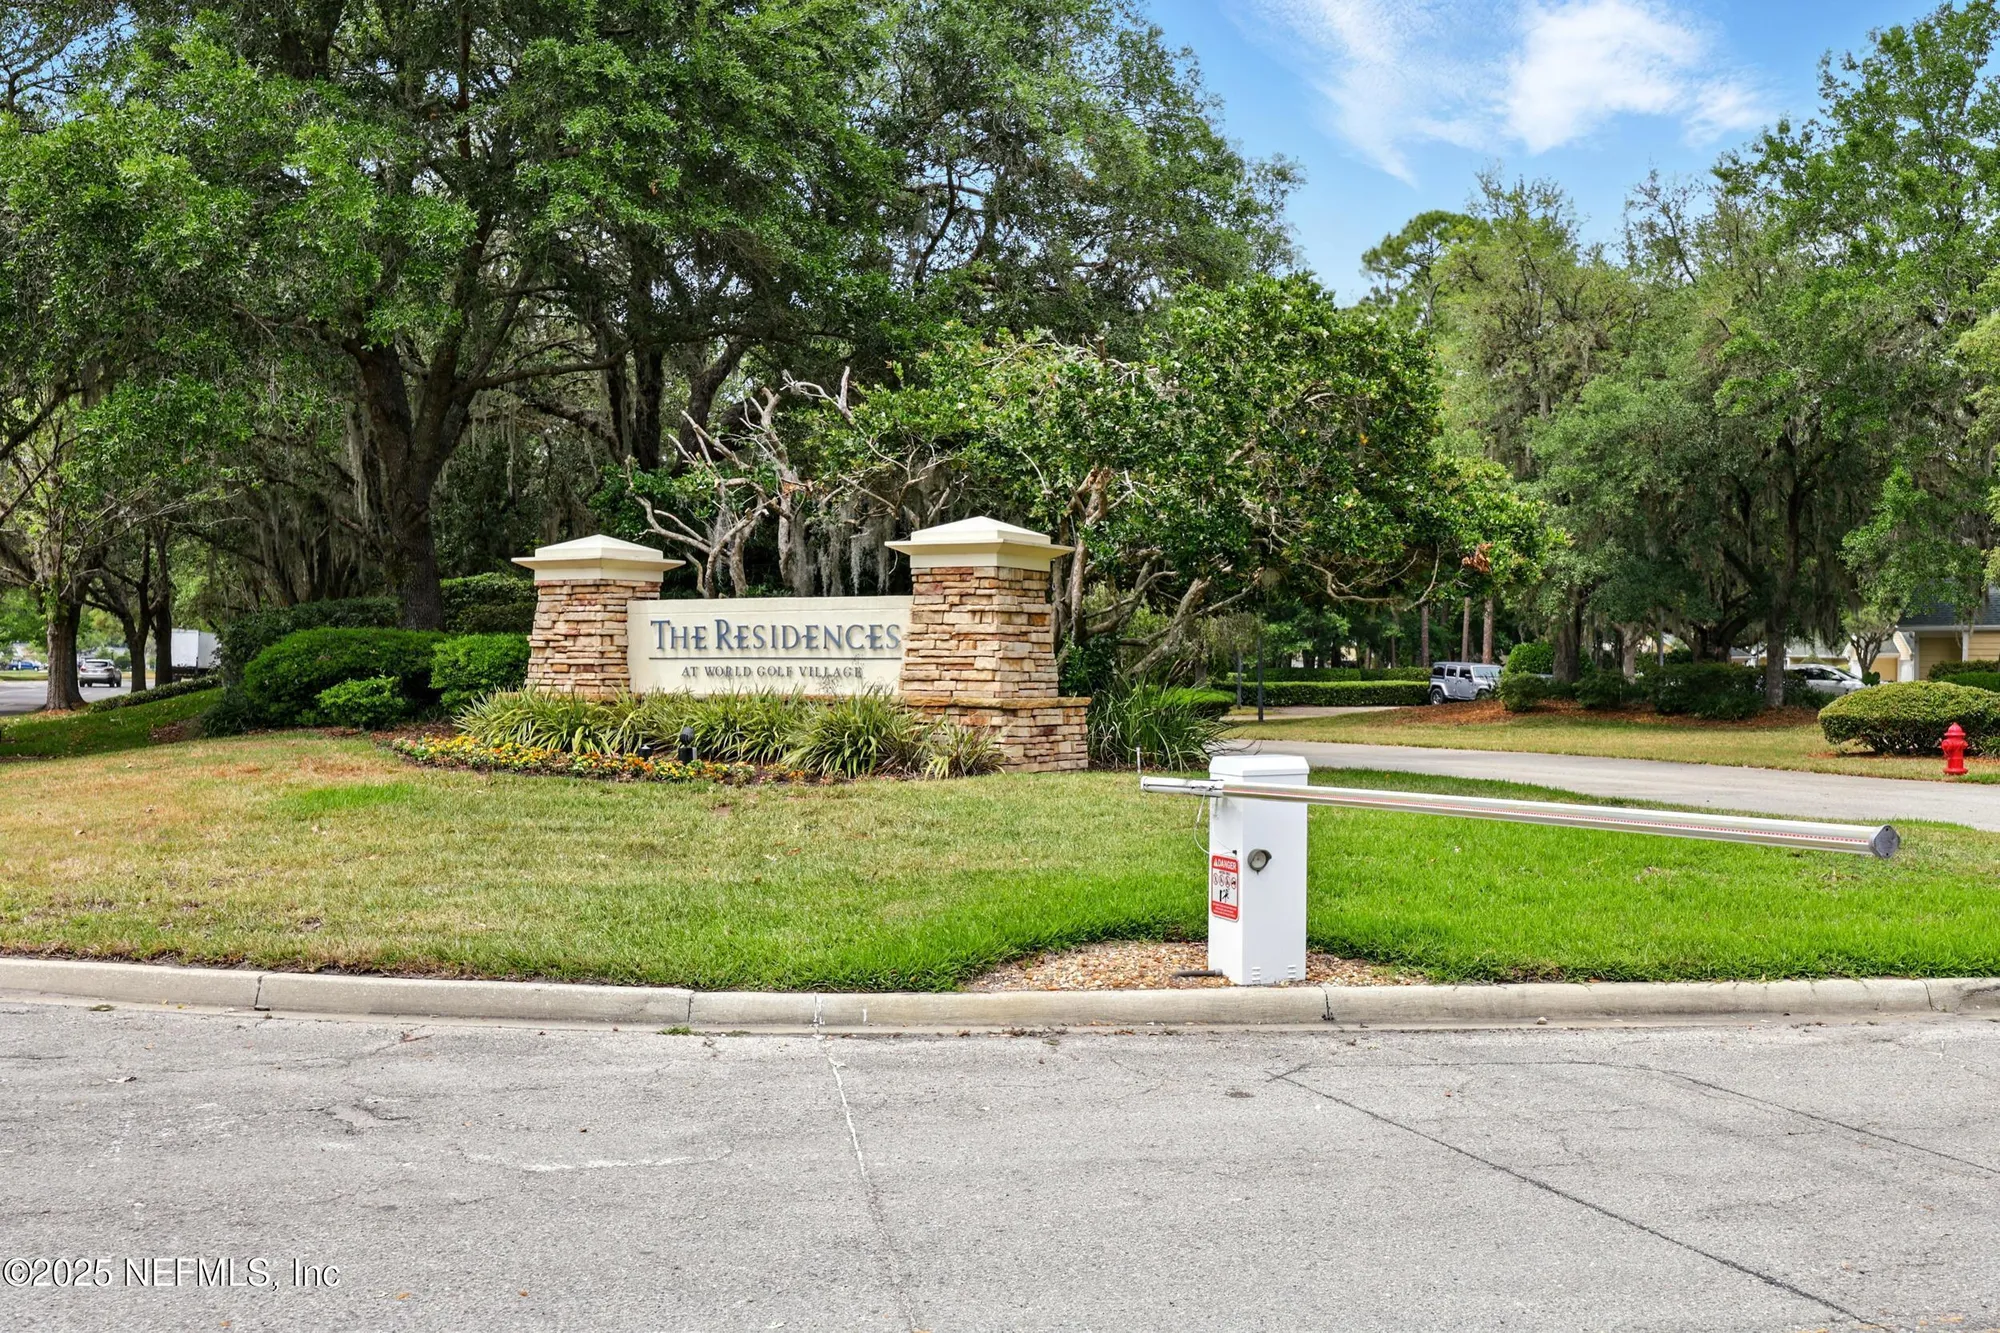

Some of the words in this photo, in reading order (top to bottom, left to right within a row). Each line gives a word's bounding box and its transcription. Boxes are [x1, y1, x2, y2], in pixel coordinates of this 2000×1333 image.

[650, 619, 708, 650] THE
[714, 618, 901, 650] RESIDENCES
[681, 666, 699, 677] AT
[704, 665, 752, 678] WORLD
[757, 665, 793, 678] GOLF
[799, 665, 864, 678] VILLAGE
[1216, 858, 1237, 869] DANGER
